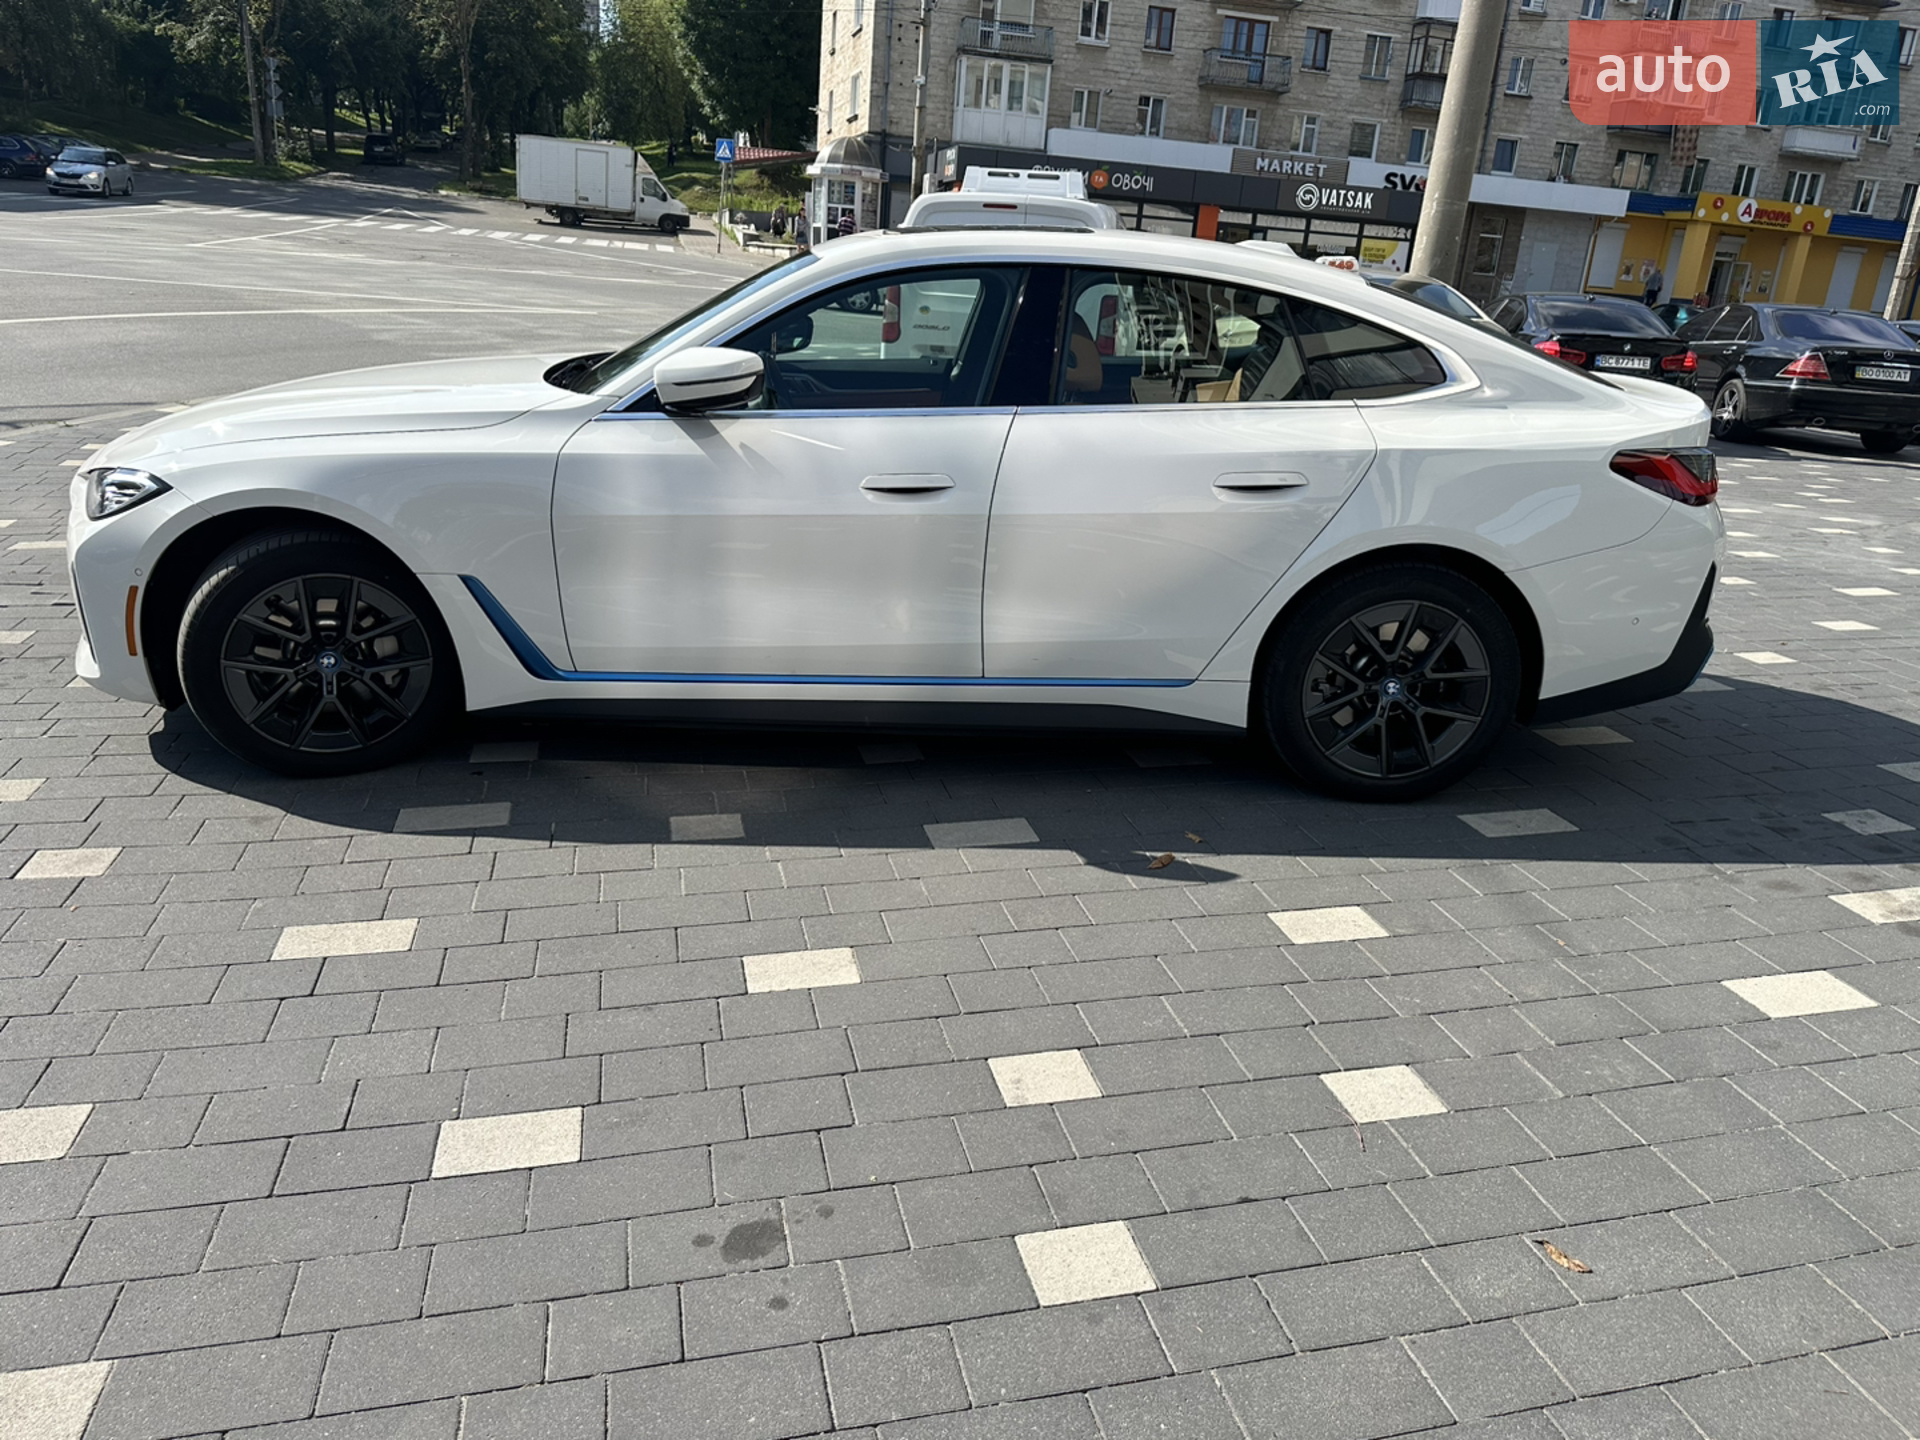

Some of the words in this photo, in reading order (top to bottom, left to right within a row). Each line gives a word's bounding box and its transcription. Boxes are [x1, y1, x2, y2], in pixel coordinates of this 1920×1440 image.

[1256, 157, 1328, 178] MARKET
[1111, 173, 1154, 192] ОВОЧІ
[1321, 187, 1374, 209] VATSAK
